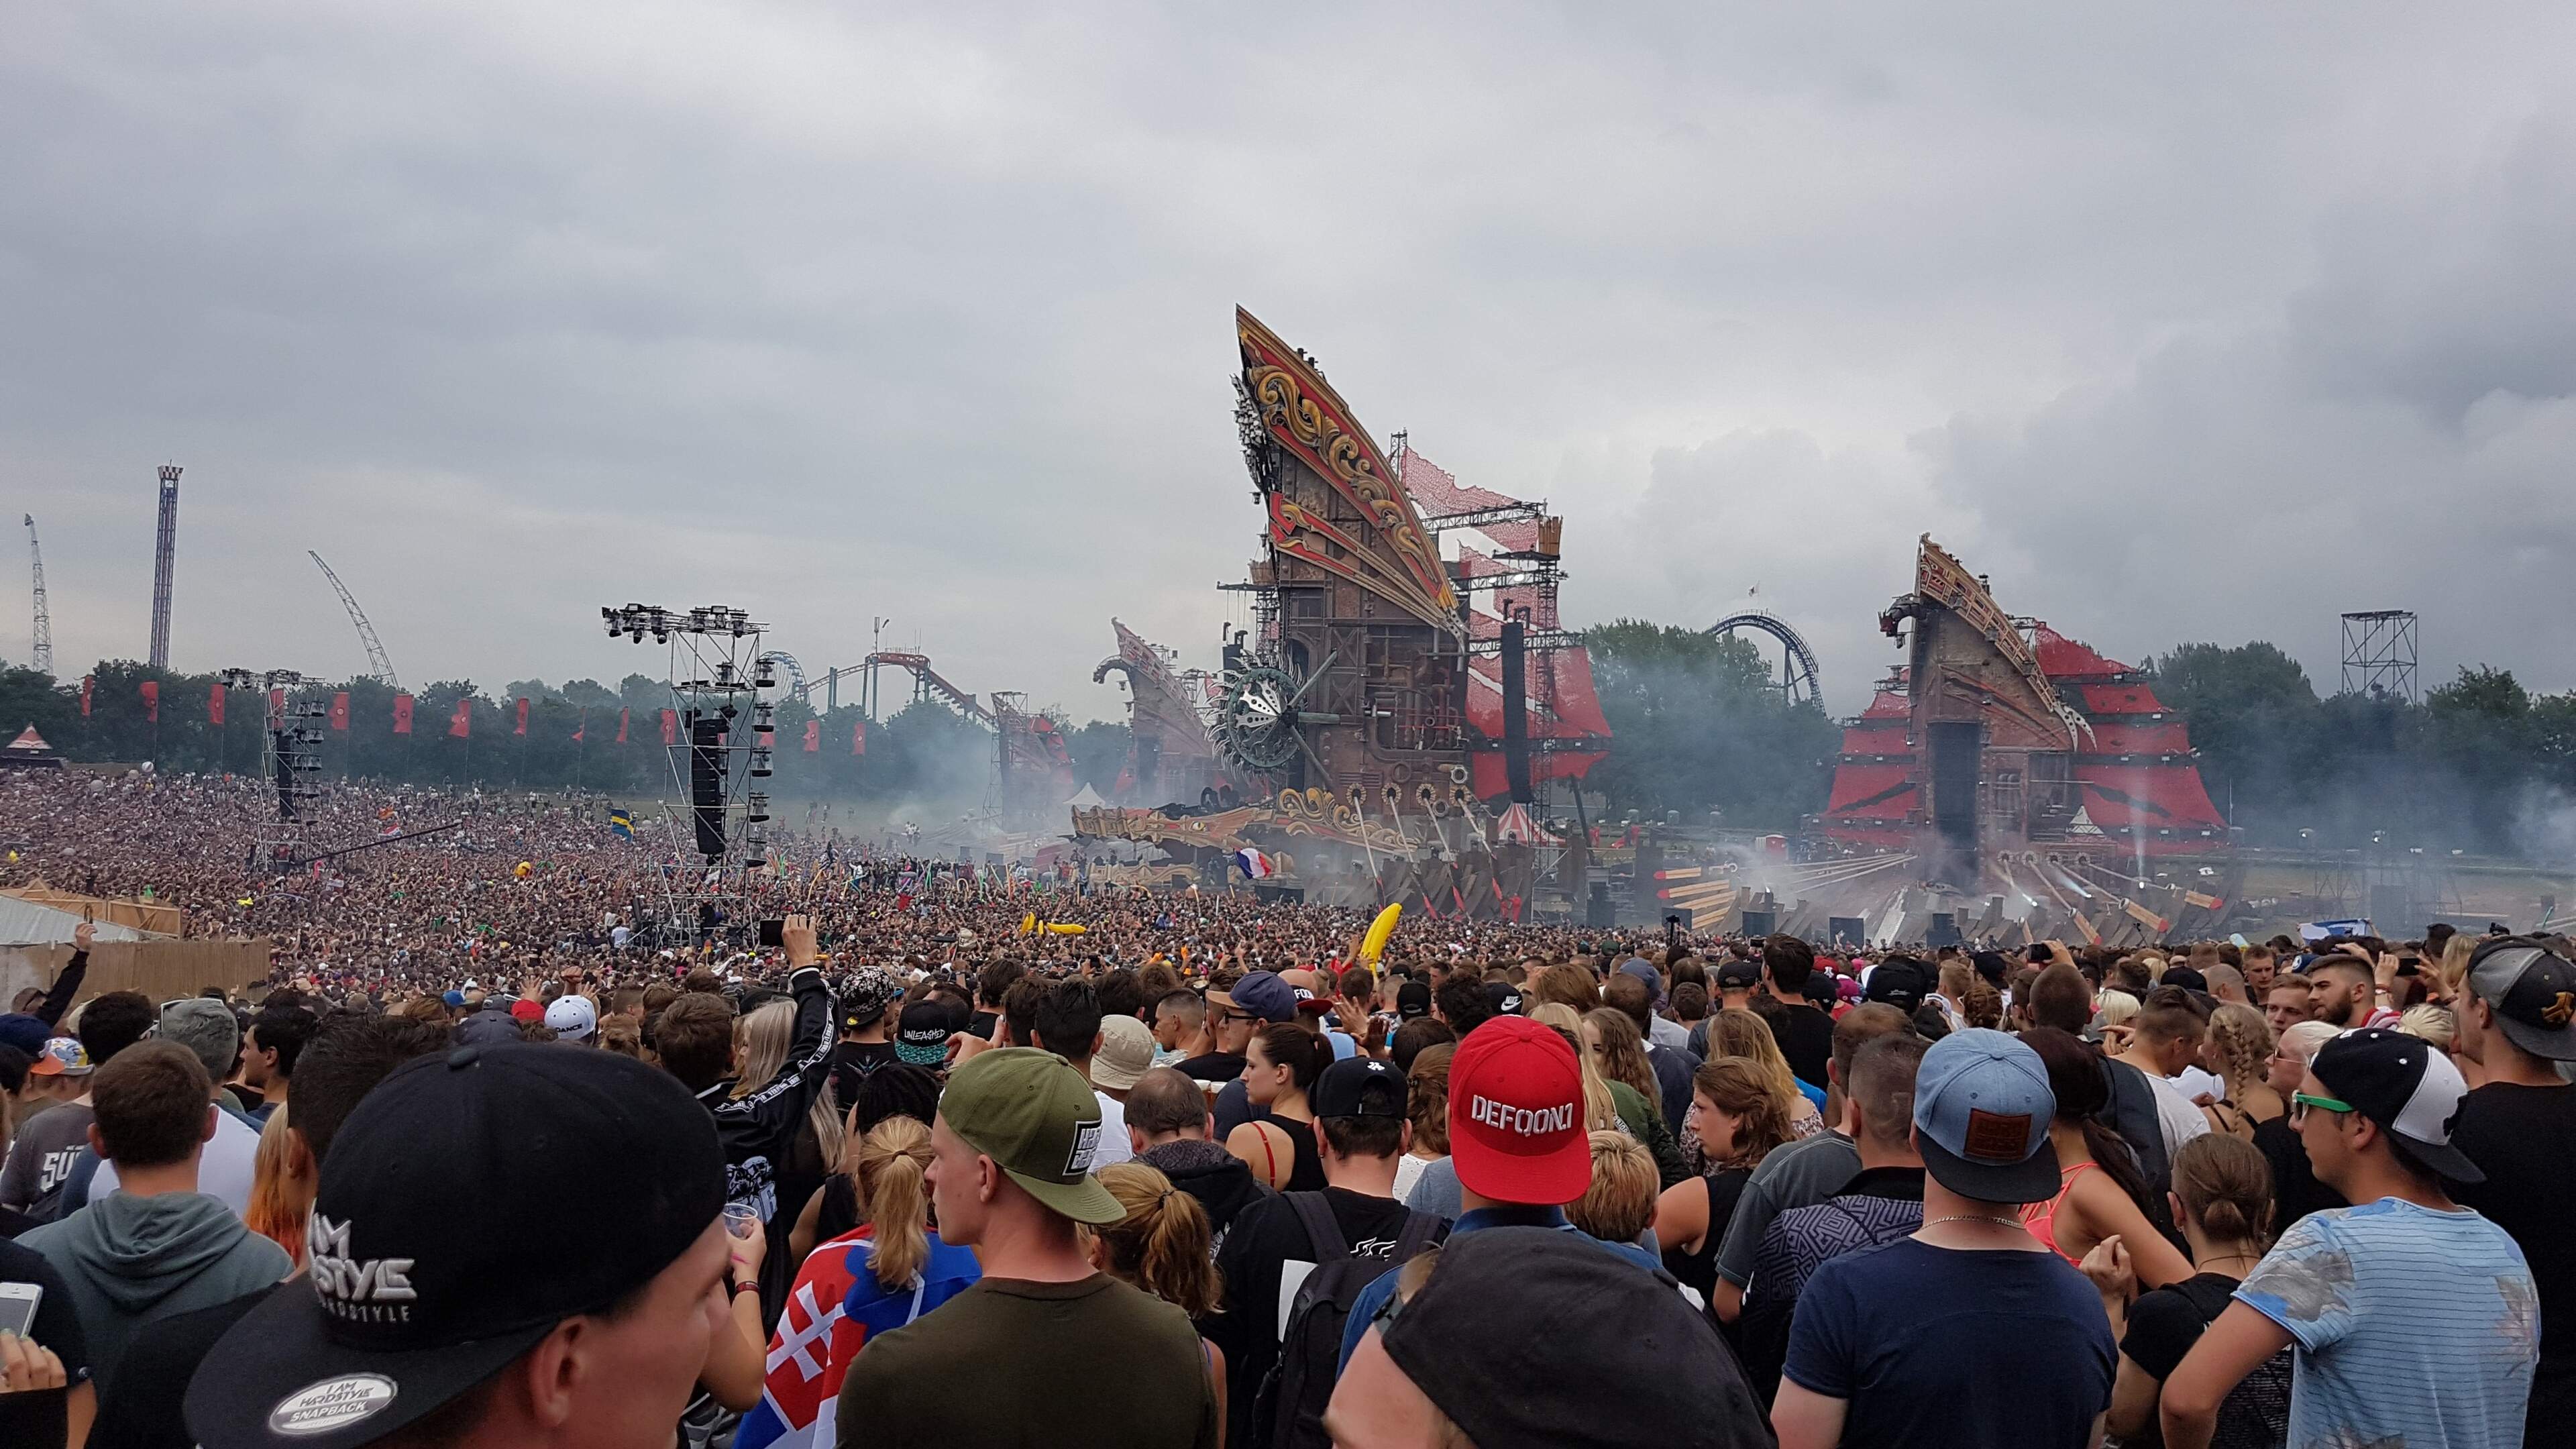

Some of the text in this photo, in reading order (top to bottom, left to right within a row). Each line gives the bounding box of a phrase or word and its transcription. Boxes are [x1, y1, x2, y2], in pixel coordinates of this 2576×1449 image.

[555, 1023, 583, 1033] DANCE
[904, 1028, 945, 1041] UNLEASHED
[1471, 1094, 1573, 1137] DEFQON.1
[335, 1381, 358, 1395] AM
[299, 1387, 374, 1408] HARDSTYLE
[289, 1400, 368, 1423] SNAPBACK
